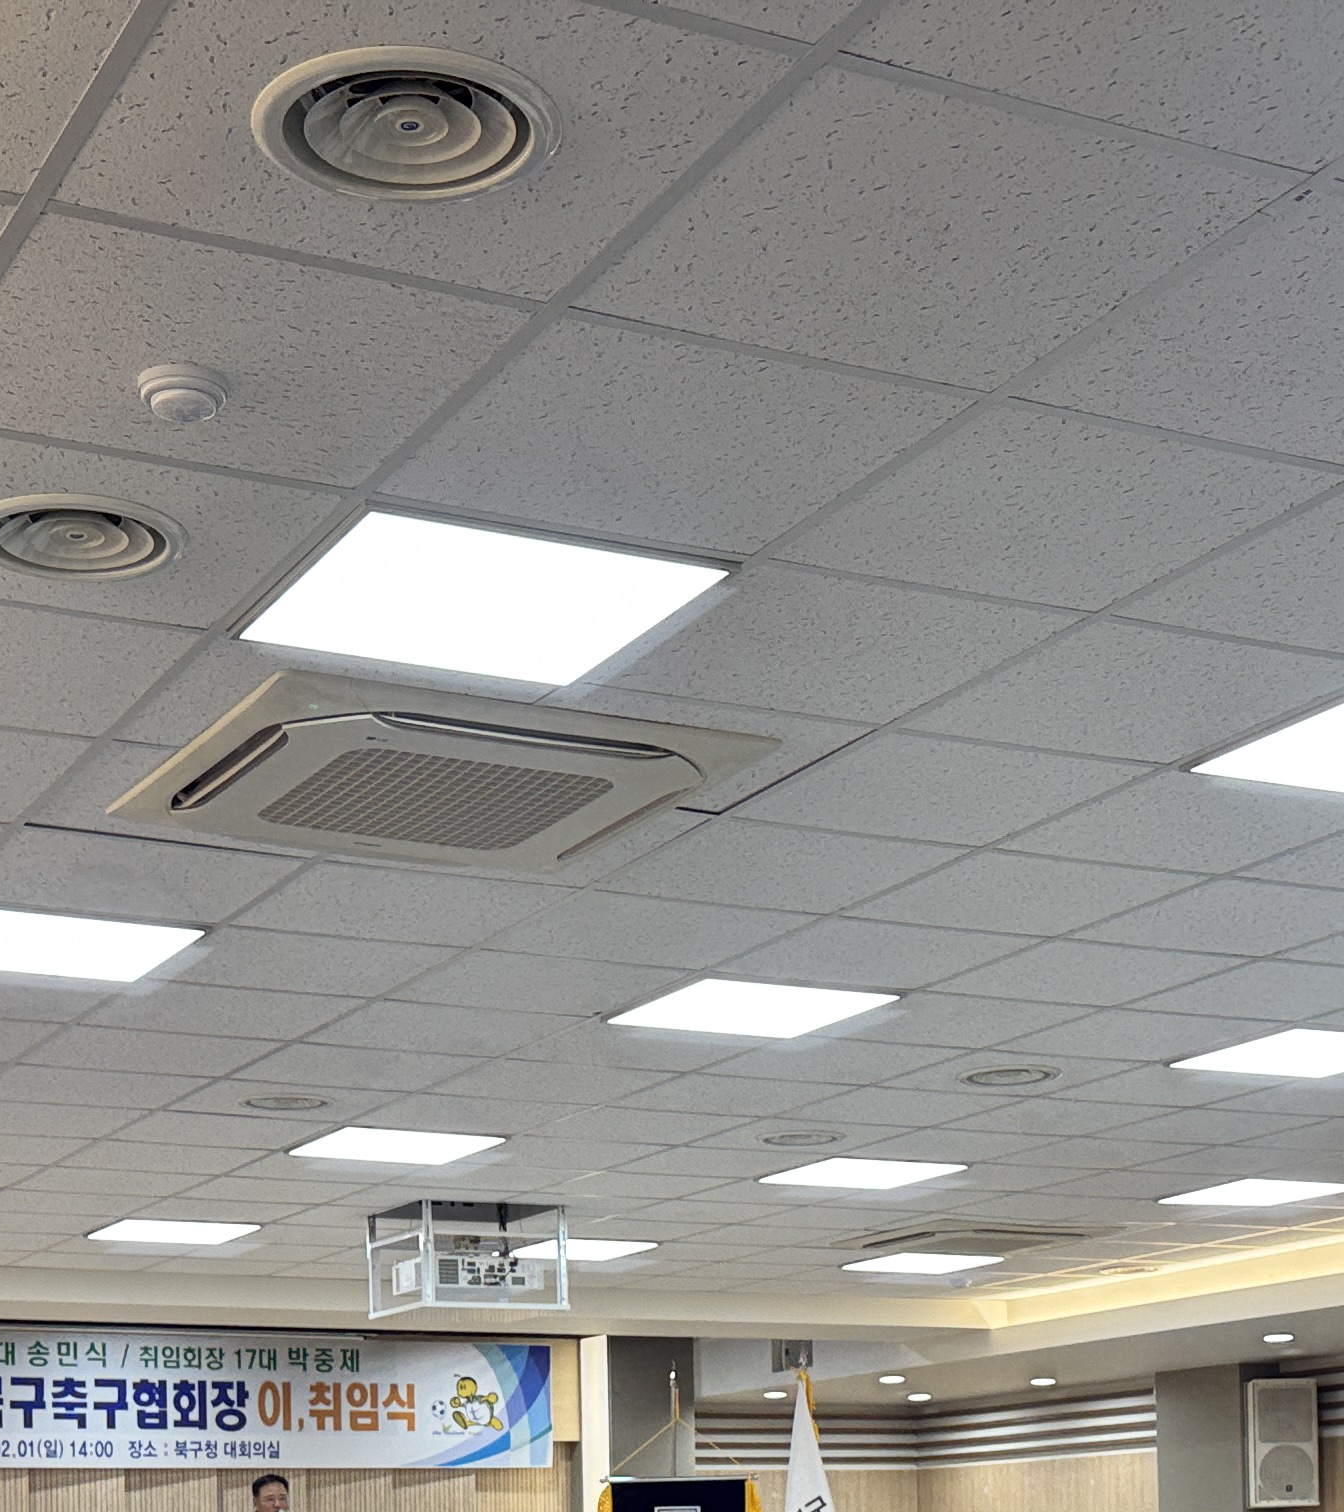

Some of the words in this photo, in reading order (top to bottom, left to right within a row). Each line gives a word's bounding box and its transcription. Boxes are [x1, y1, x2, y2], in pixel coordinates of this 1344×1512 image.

[139, 1345, 225, 1370] 취임회장
[234, 1347, 277, 1371] 17대
[70, 1440, 114, 1458] 14:00
[128, 1440, 158, 1458] 장소
[174, 1440, 219, 1459] 북구청
[224, 1440, 280, 1459] 대회의실
